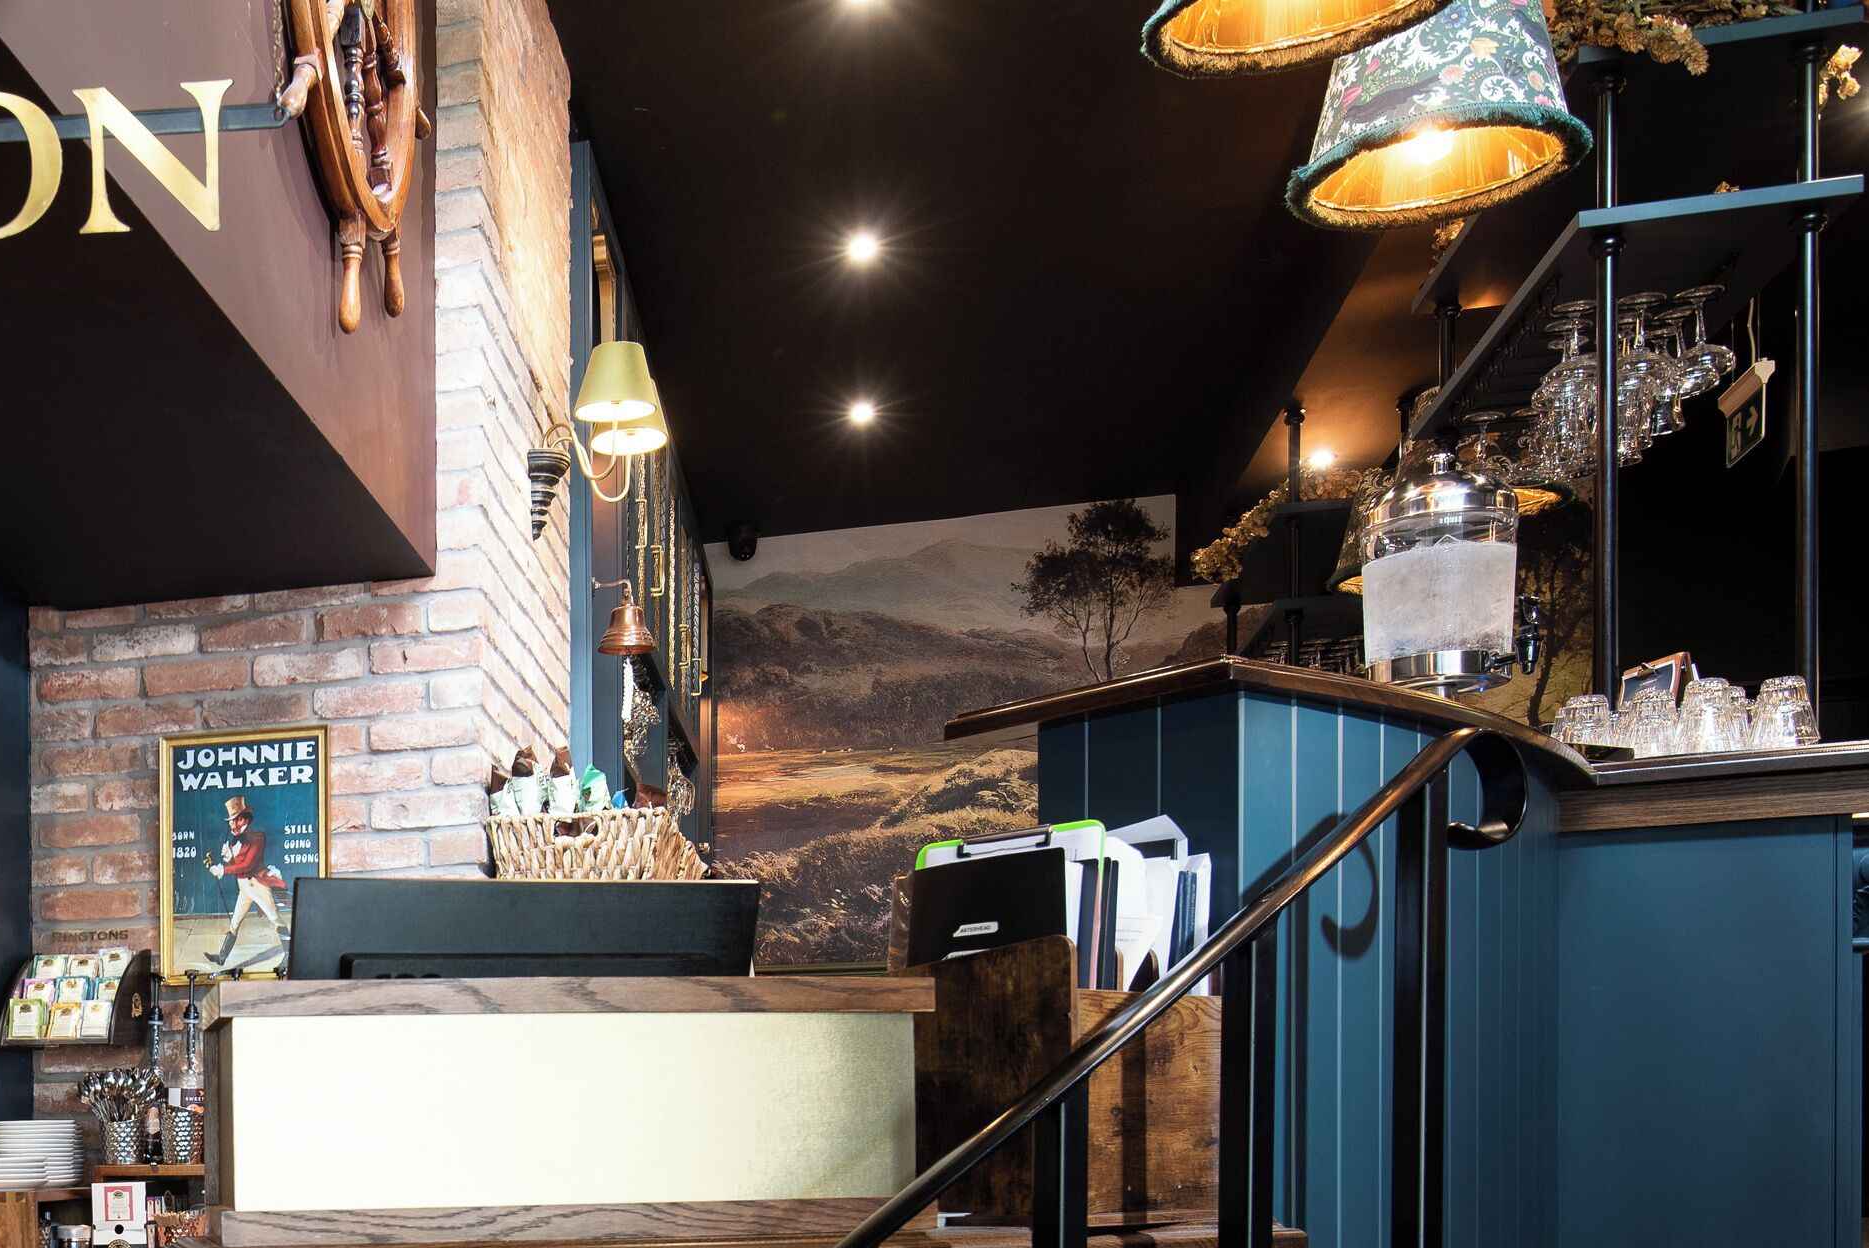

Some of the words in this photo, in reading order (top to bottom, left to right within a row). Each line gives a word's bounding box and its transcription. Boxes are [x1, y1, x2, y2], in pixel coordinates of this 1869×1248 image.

[177, 741, 316, 770] JOHNNIE
[179, 765, 314, 791] WALKER
[172, 830, 195, 841] BORN
[284, 824, 313, 835] STILL
[284, 839, 311, 850] GOING
[51, 929, 129, 942] RINGTONS
